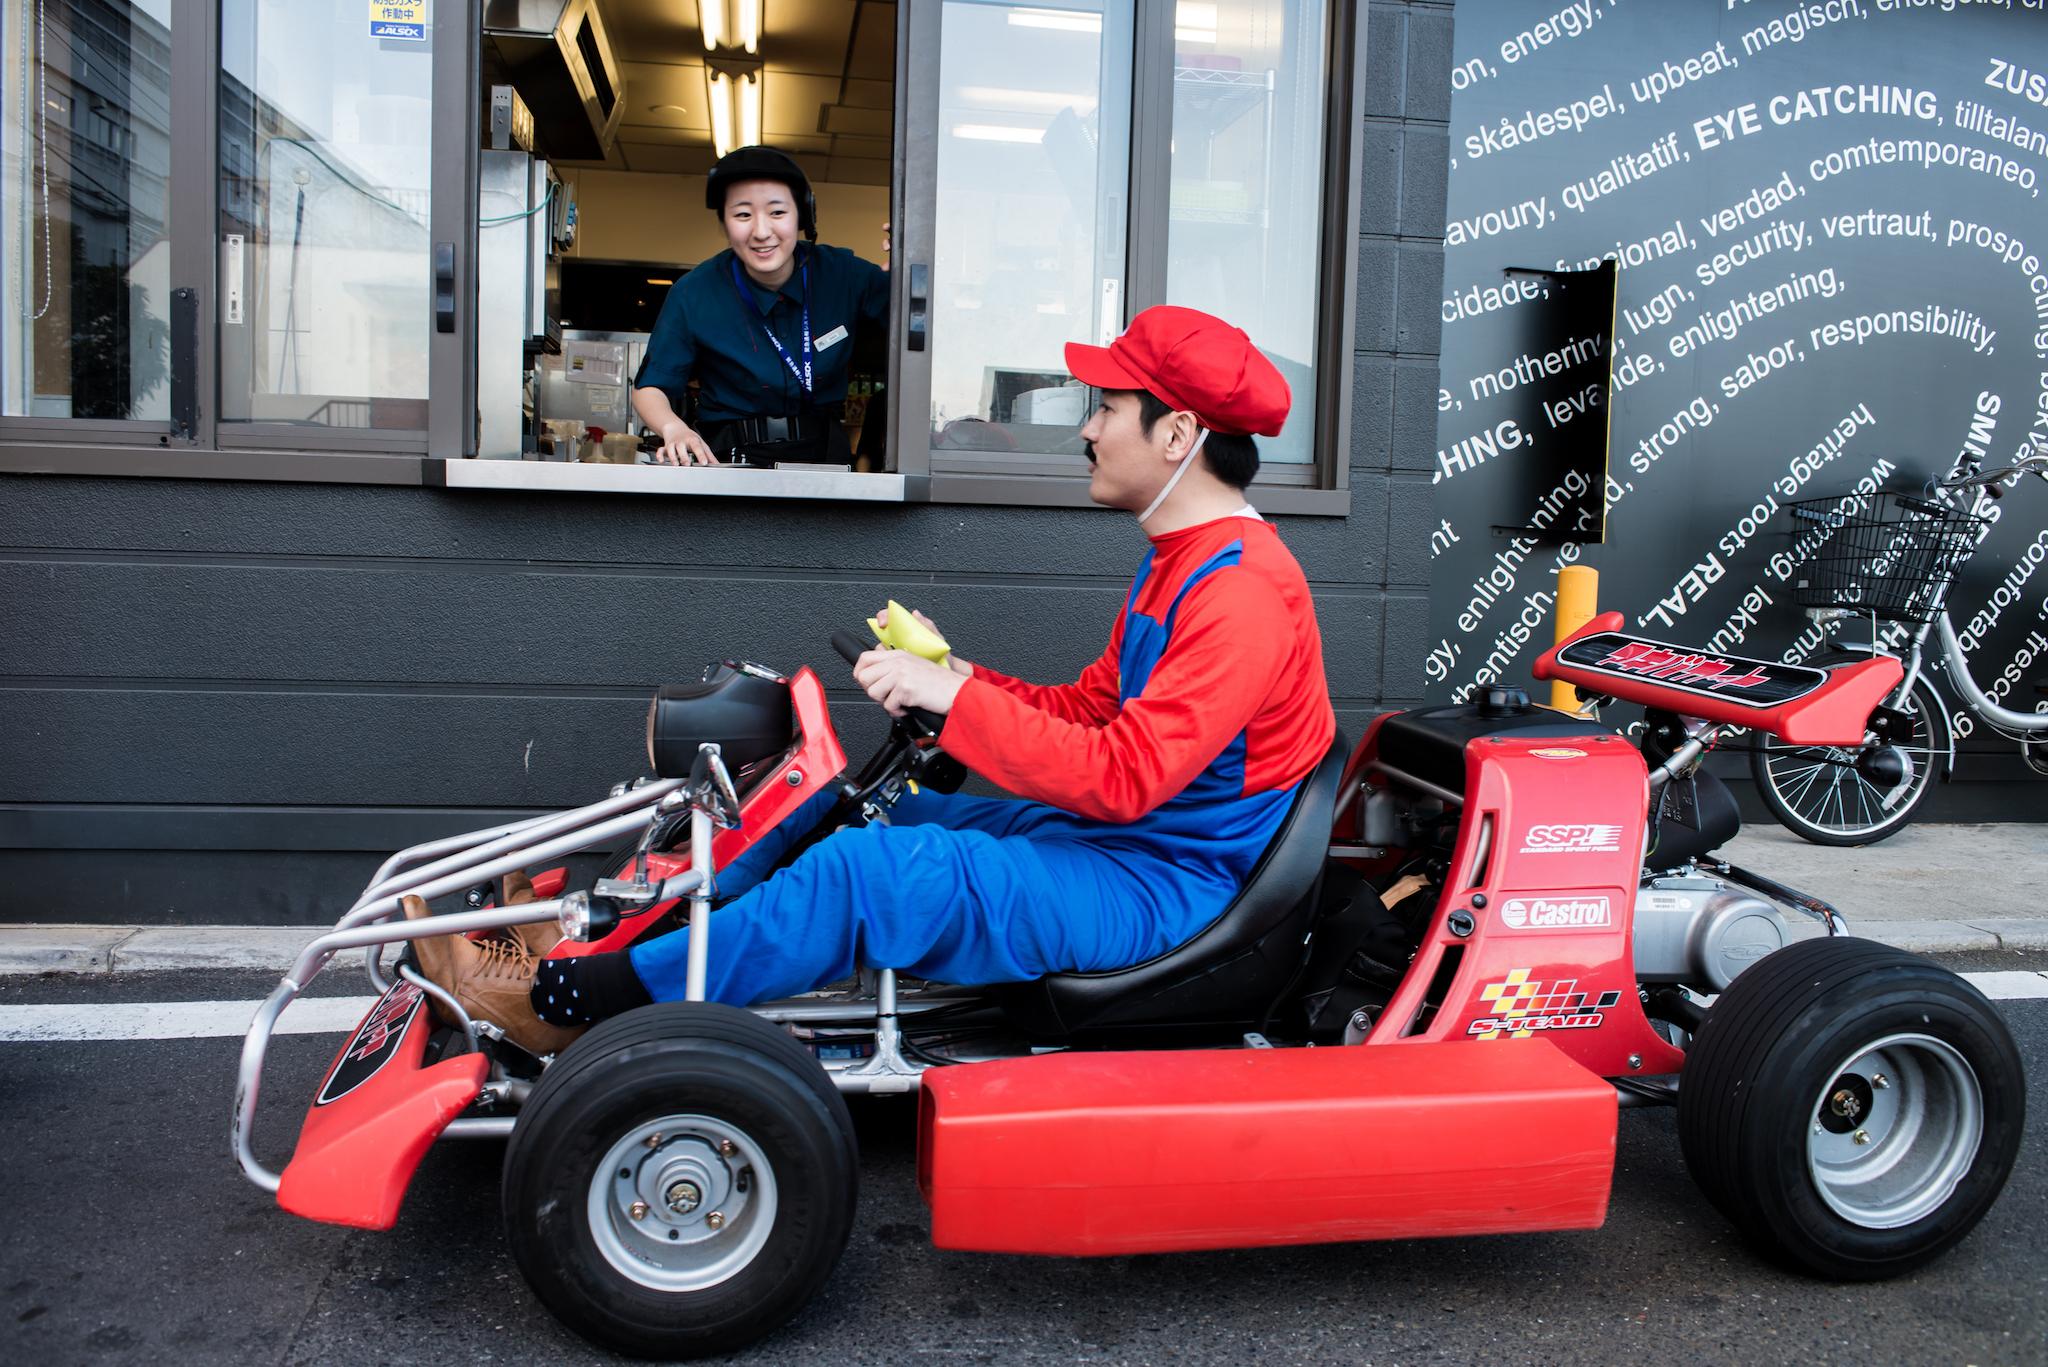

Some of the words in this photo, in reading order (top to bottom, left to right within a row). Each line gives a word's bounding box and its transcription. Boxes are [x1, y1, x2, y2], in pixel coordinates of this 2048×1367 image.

[382, 8, 414, 19] 作動中
[1451, 57, 1497, 93] on,
[1500, 0, 1602, 63] energy,
[1465, 84, 1625, 159] skådespel,
[1631, 41, 1738, 103] upbeat,
[1741, 0, 1868, 55] magisch,
[1985, 58, 2048, 107] ZUS
[1443, 197, 1556, 247] avoury,
[1562, 132, 1690, 213] qualitatif,
[1693, 103, 1762, 151] EYE
[1768, 84, 1943, 126] CATCHING,
[1955, 100, 2048, 157] tilltalan
[1701, 171, 1805, 240] verdad,
[1809, 137, 2040, 198] comtemporaneo,
[1470, 333, 1626, 400] motherin,
[1624, 283, 1695, 335] lugn,
[1696, 215, 1812, 286] security,
[1821, 209, 1937, 240] vertraut,
[1432, 419, 1533, 485] HING,
[1669, 268, 1845, 358] enlightening,
[1629, 396, 1719, 473] strong,
[1720, 339, 1804, 399] sabor,
[1810, 305, 1996, 356] responsibility,
[1773, 402, 1876, 496] heritage,
[1719, 494, 1779, 558] roots
[1637, 552, 1726, 628] REAL,
[1426, 638, 1461, 686] gy,
[1530, 900, 1606, 925] Castrol
